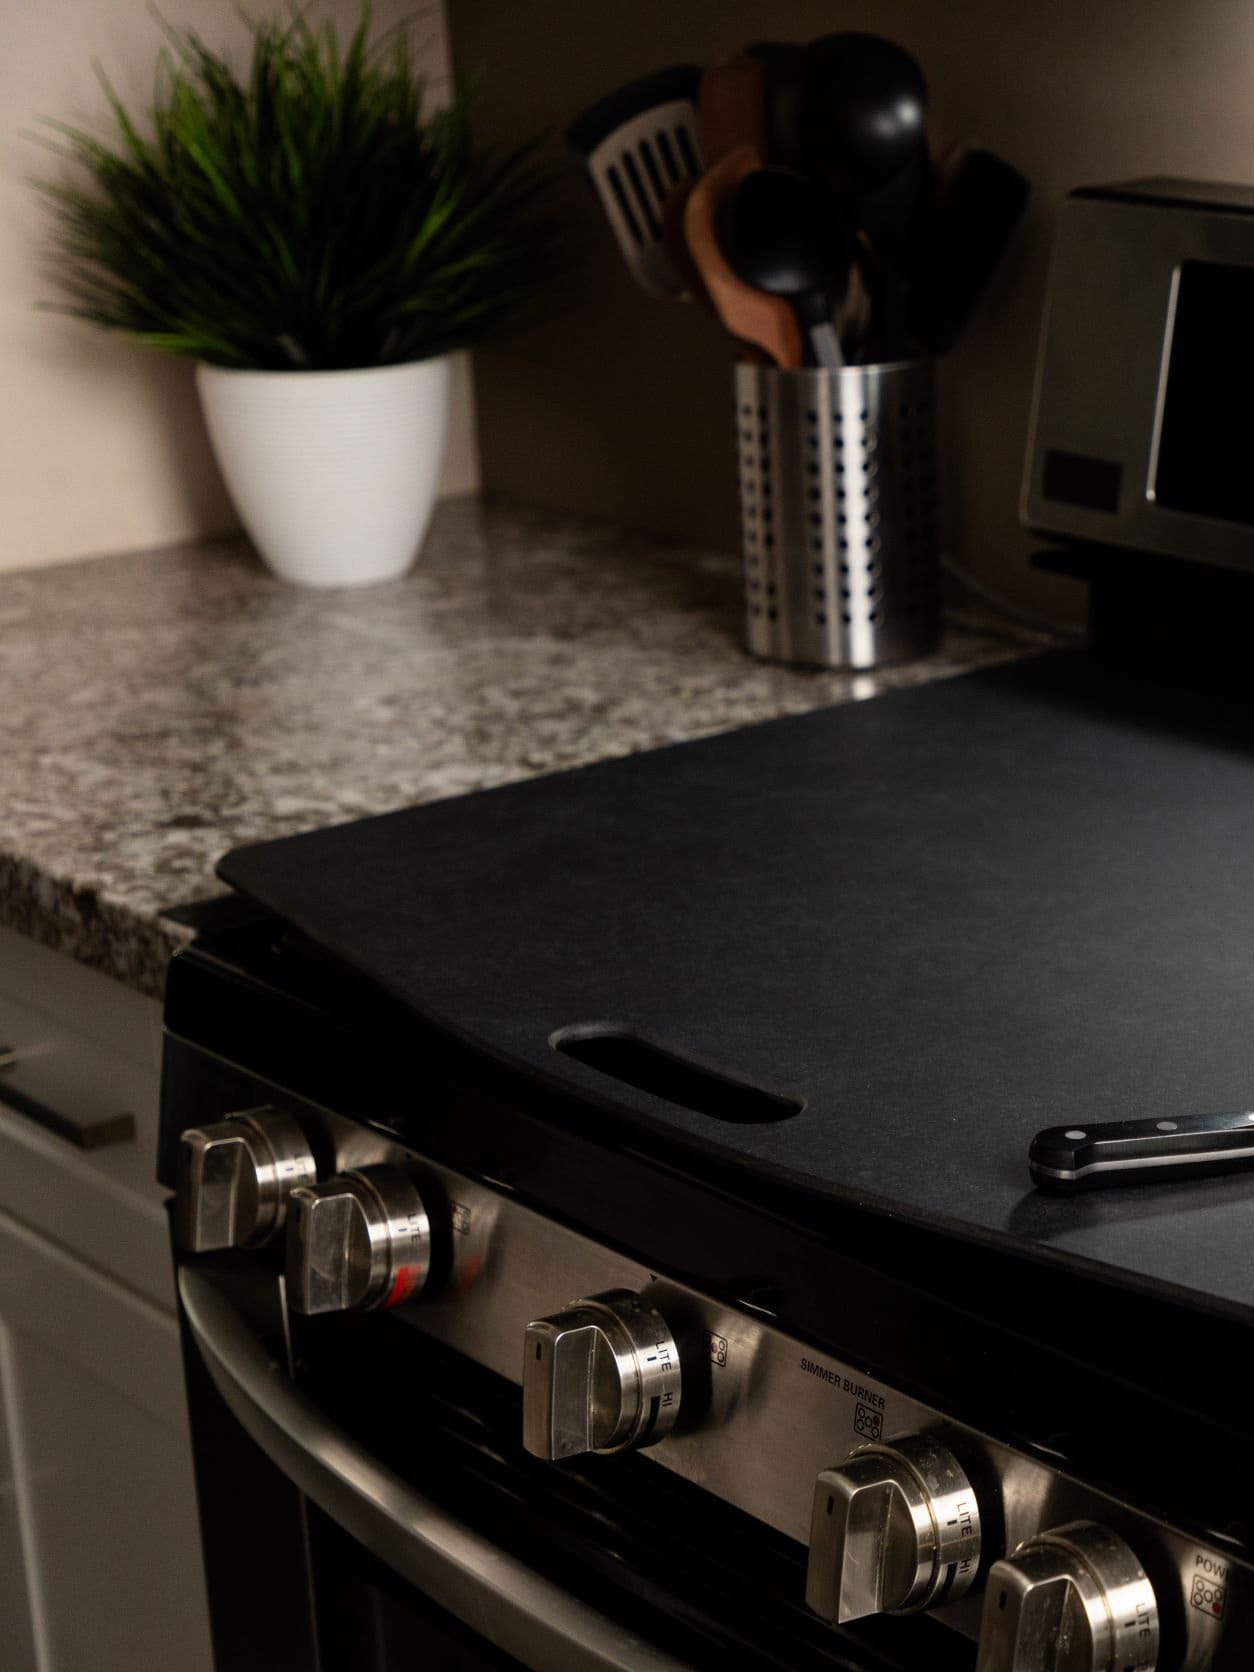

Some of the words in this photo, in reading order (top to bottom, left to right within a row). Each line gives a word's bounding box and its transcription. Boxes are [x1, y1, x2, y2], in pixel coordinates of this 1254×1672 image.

[656, 1340, 672, 1372] LITE
[662, 1392, 673, 1407] HI
[800, 1358, 841, 1388] SIMMER
[843, 1379, 886, 1410] BURNER
[957, 1502, 972, 1537] LITE
[959, 1558, 971, 1574] HI
[1136, 1602, 1151, 1638] LITE
